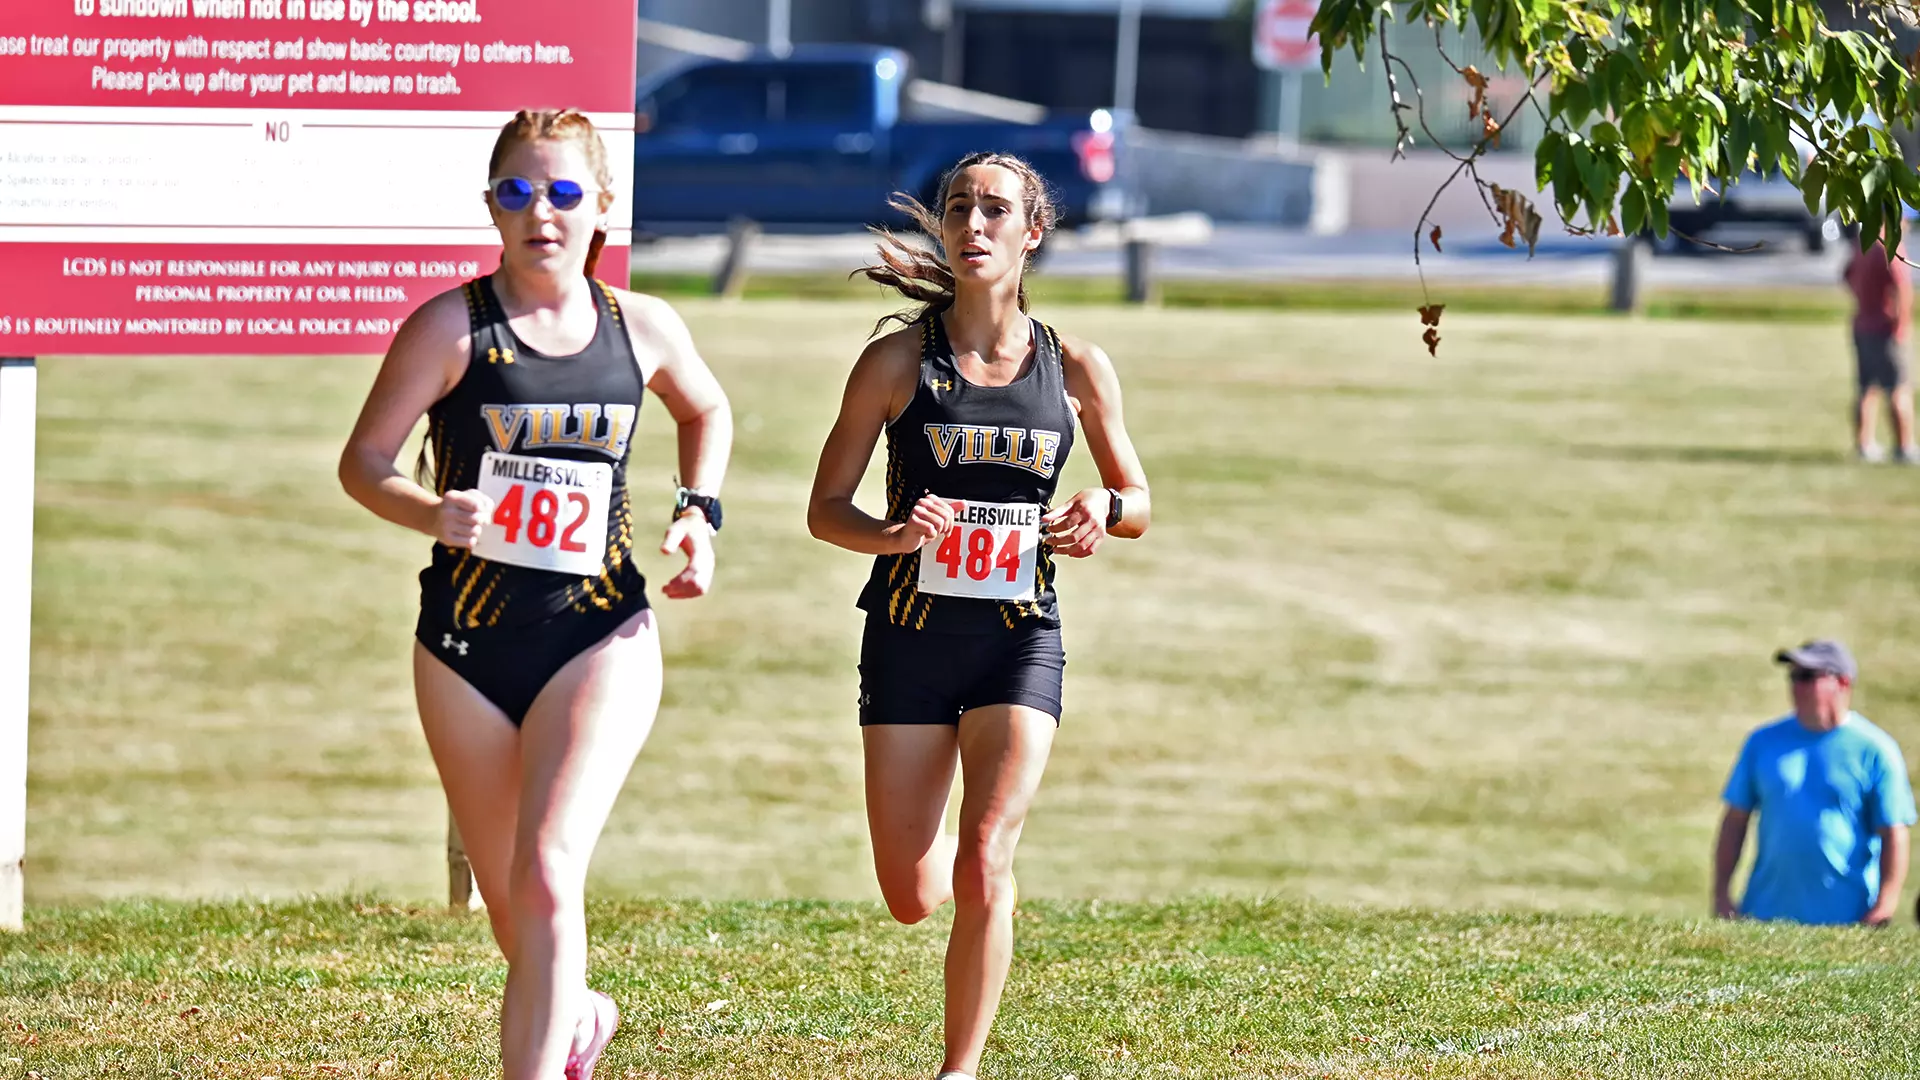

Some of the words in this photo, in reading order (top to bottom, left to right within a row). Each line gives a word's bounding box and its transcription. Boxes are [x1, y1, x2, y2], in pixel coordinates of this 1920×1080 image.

[75, 0, 94, 16] to
[100, 0, 187, 17] sundown
[192, 0, 245, 19] when
[250, 0, 282, 19] not
[287, 0, 305, 20] in
[310, 0, 345, 20] use
[349, 0, 373, 27] by
[378, 0, 409, 22] the
[413, 0, 481, 23] school.
[0, 37, 26, 55] ase
[31, 35, 69, 56] treat
[73, 38, 100, 56] our
[104, 37, 171, 62] property
[174, 35, 208, 57] with
[212, 38, 270, 63] respect
[274, 37, 303, 60] and
[307, 37, 347, 60] show
[350, 38, 391, 61] basic
[394, 41, 461, 67] courtesy
[464, 42, 480, 62] to
[483, 40, 532, 63] others
[535, 41, 574, 64] here.
[92, 66, 144, 90] Please
[148, 68, 180, 94] pick
[184, 73, 205, 95] up
[208, 68, 247, 91] after
[250, 74, 285, 97] your
[288, 72, 313, 96] pet
[317, 70, 346, 93] and
[349, 71, 390, 93] leave
[393, 76, 413, 94] no
[416, 72, 461, 94] trash.
[265, 121, 290, 142] NO
[63, 258, 106, 276] LCDS
[111, 260, 125, 275] IS
[129, 260, 162, 276] NOT
[168, 260, 264, 276] RESPONSIBLE
[270, 261, 301, 276] FOR
[303, 261, 335, 276] ANY
[338, 261, 391, 278] INJURY
[394, 261, 417, 277] OR
[420, 261, 456, 277] LOSS
[458, 262, 480, 278] OF
[136, 286, 212, 301] PERSONAL
[217, 286, 293, 302] PROPERTY
[295, 286, 315, 302] AT
[317, 286, 351, 302] OUR
[355, 286, 408, 302] FIELDS.
[16, 318, 30, 334] IS
[35, 318, 122, 334] ROUTINELY
[125, 318, 222, 334] MONITORED
[225, 319, 244, 334] BY
[248, 318, 295, 334] LOCAL
[299, 319, 352, 334] POLICE
[355, 319, 390, 335] AND
[481, 404, 636, 461] VILLE
[924, 423, 1060, 479] VILLE
[493, 485, 591, 553] 482
[954, 506, 1032, 526] LERSVILLE
[936, 525, 1020, 582] 484
